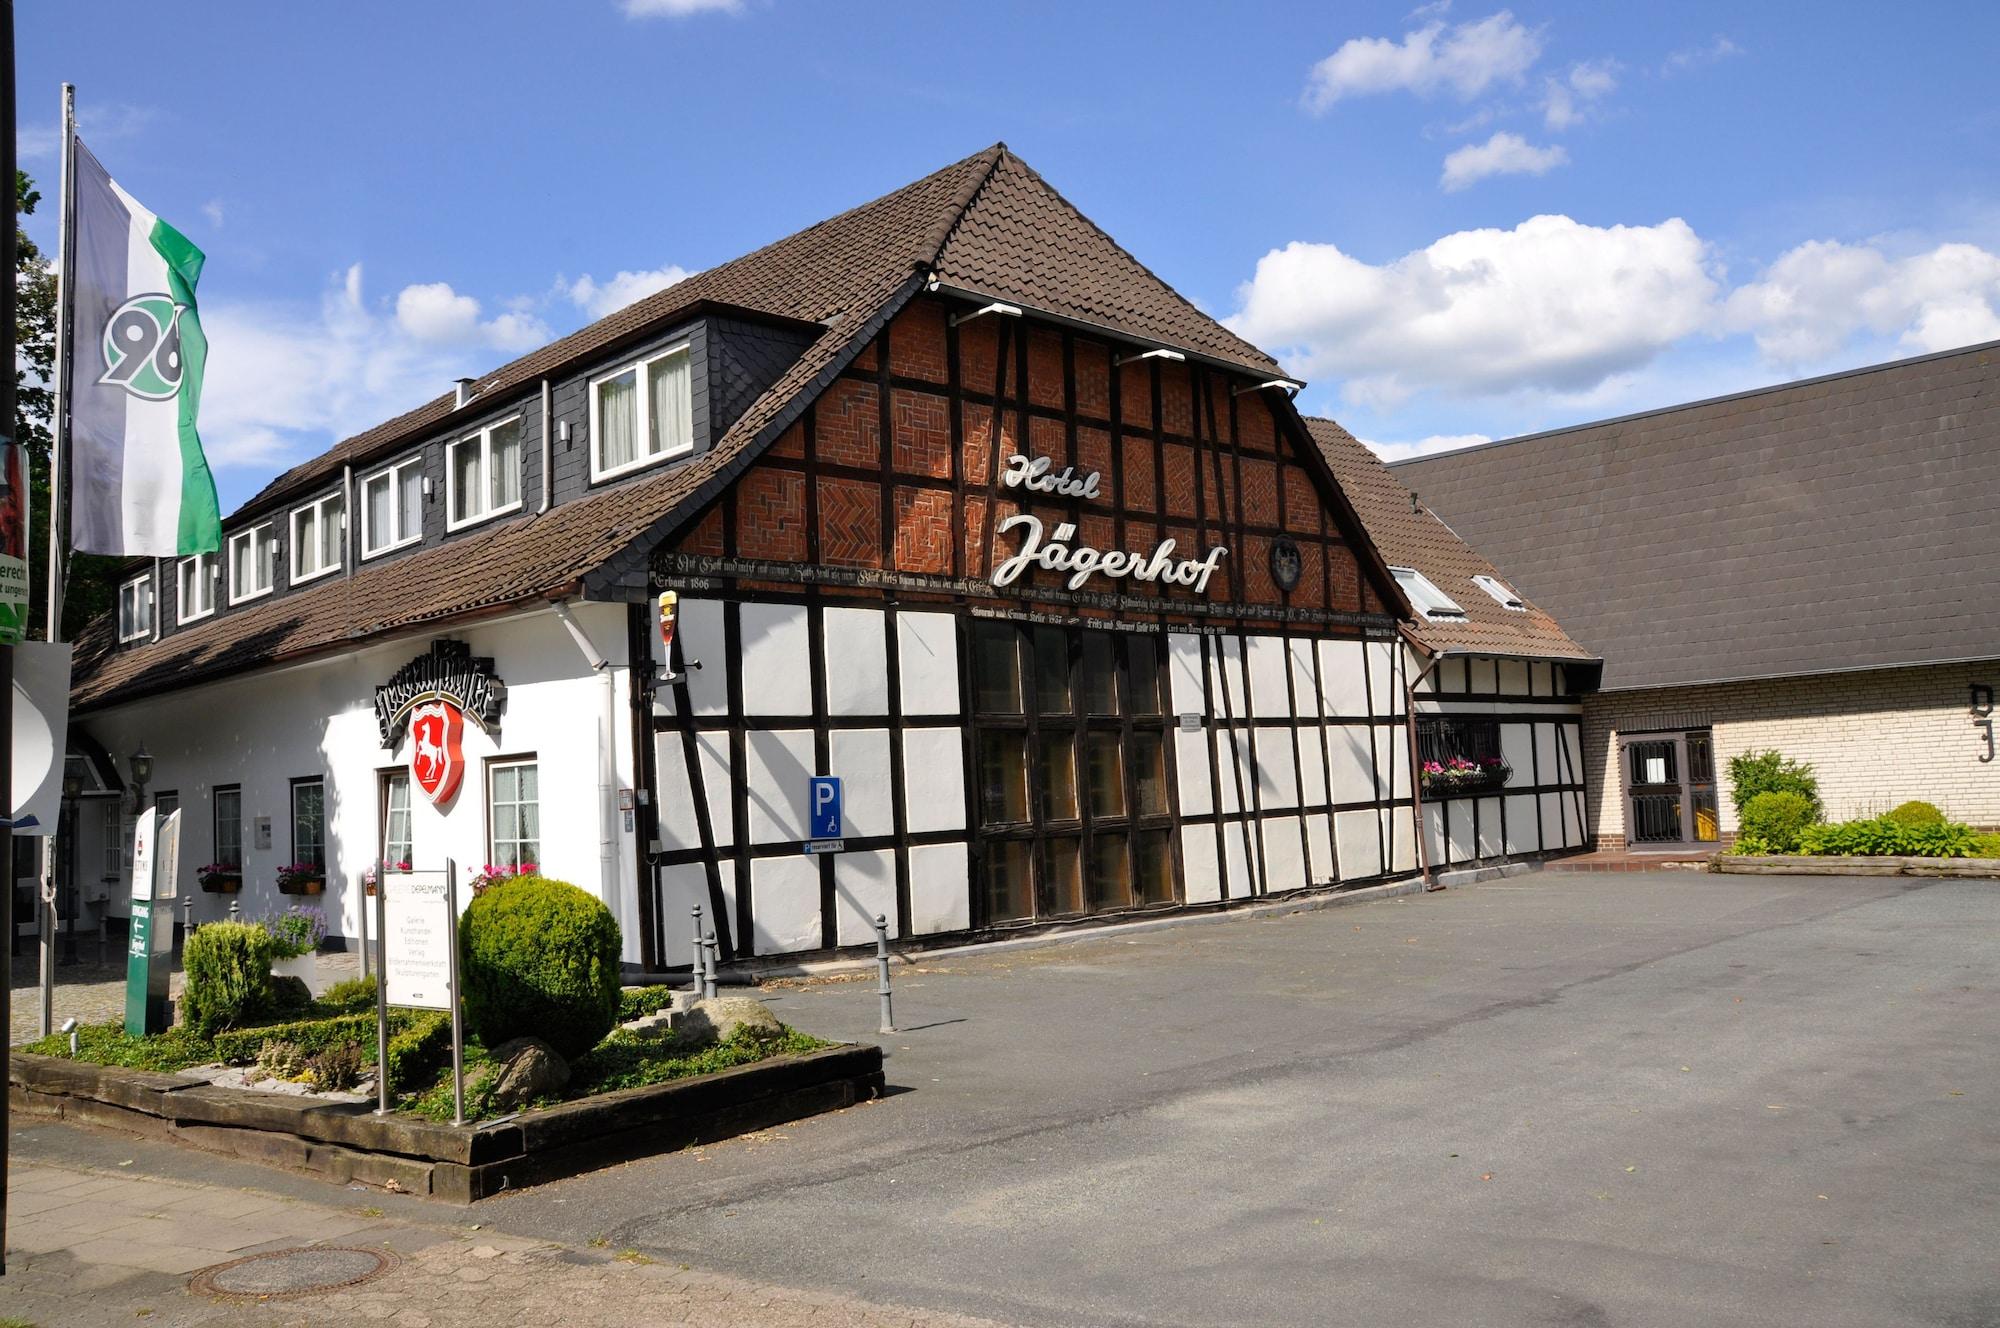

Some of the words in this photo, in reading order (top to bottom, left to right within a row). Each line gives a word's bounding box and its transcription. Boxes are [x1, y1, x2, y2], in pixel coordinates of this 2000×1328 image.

[99, 305, 185, 386] 96
[1002, 454, 1101, 499] Hotel
[990, 514, 1229, 594] Jägerhof
[690, 577, 709, 591] 1806
[815, 782, 835, 817] P
